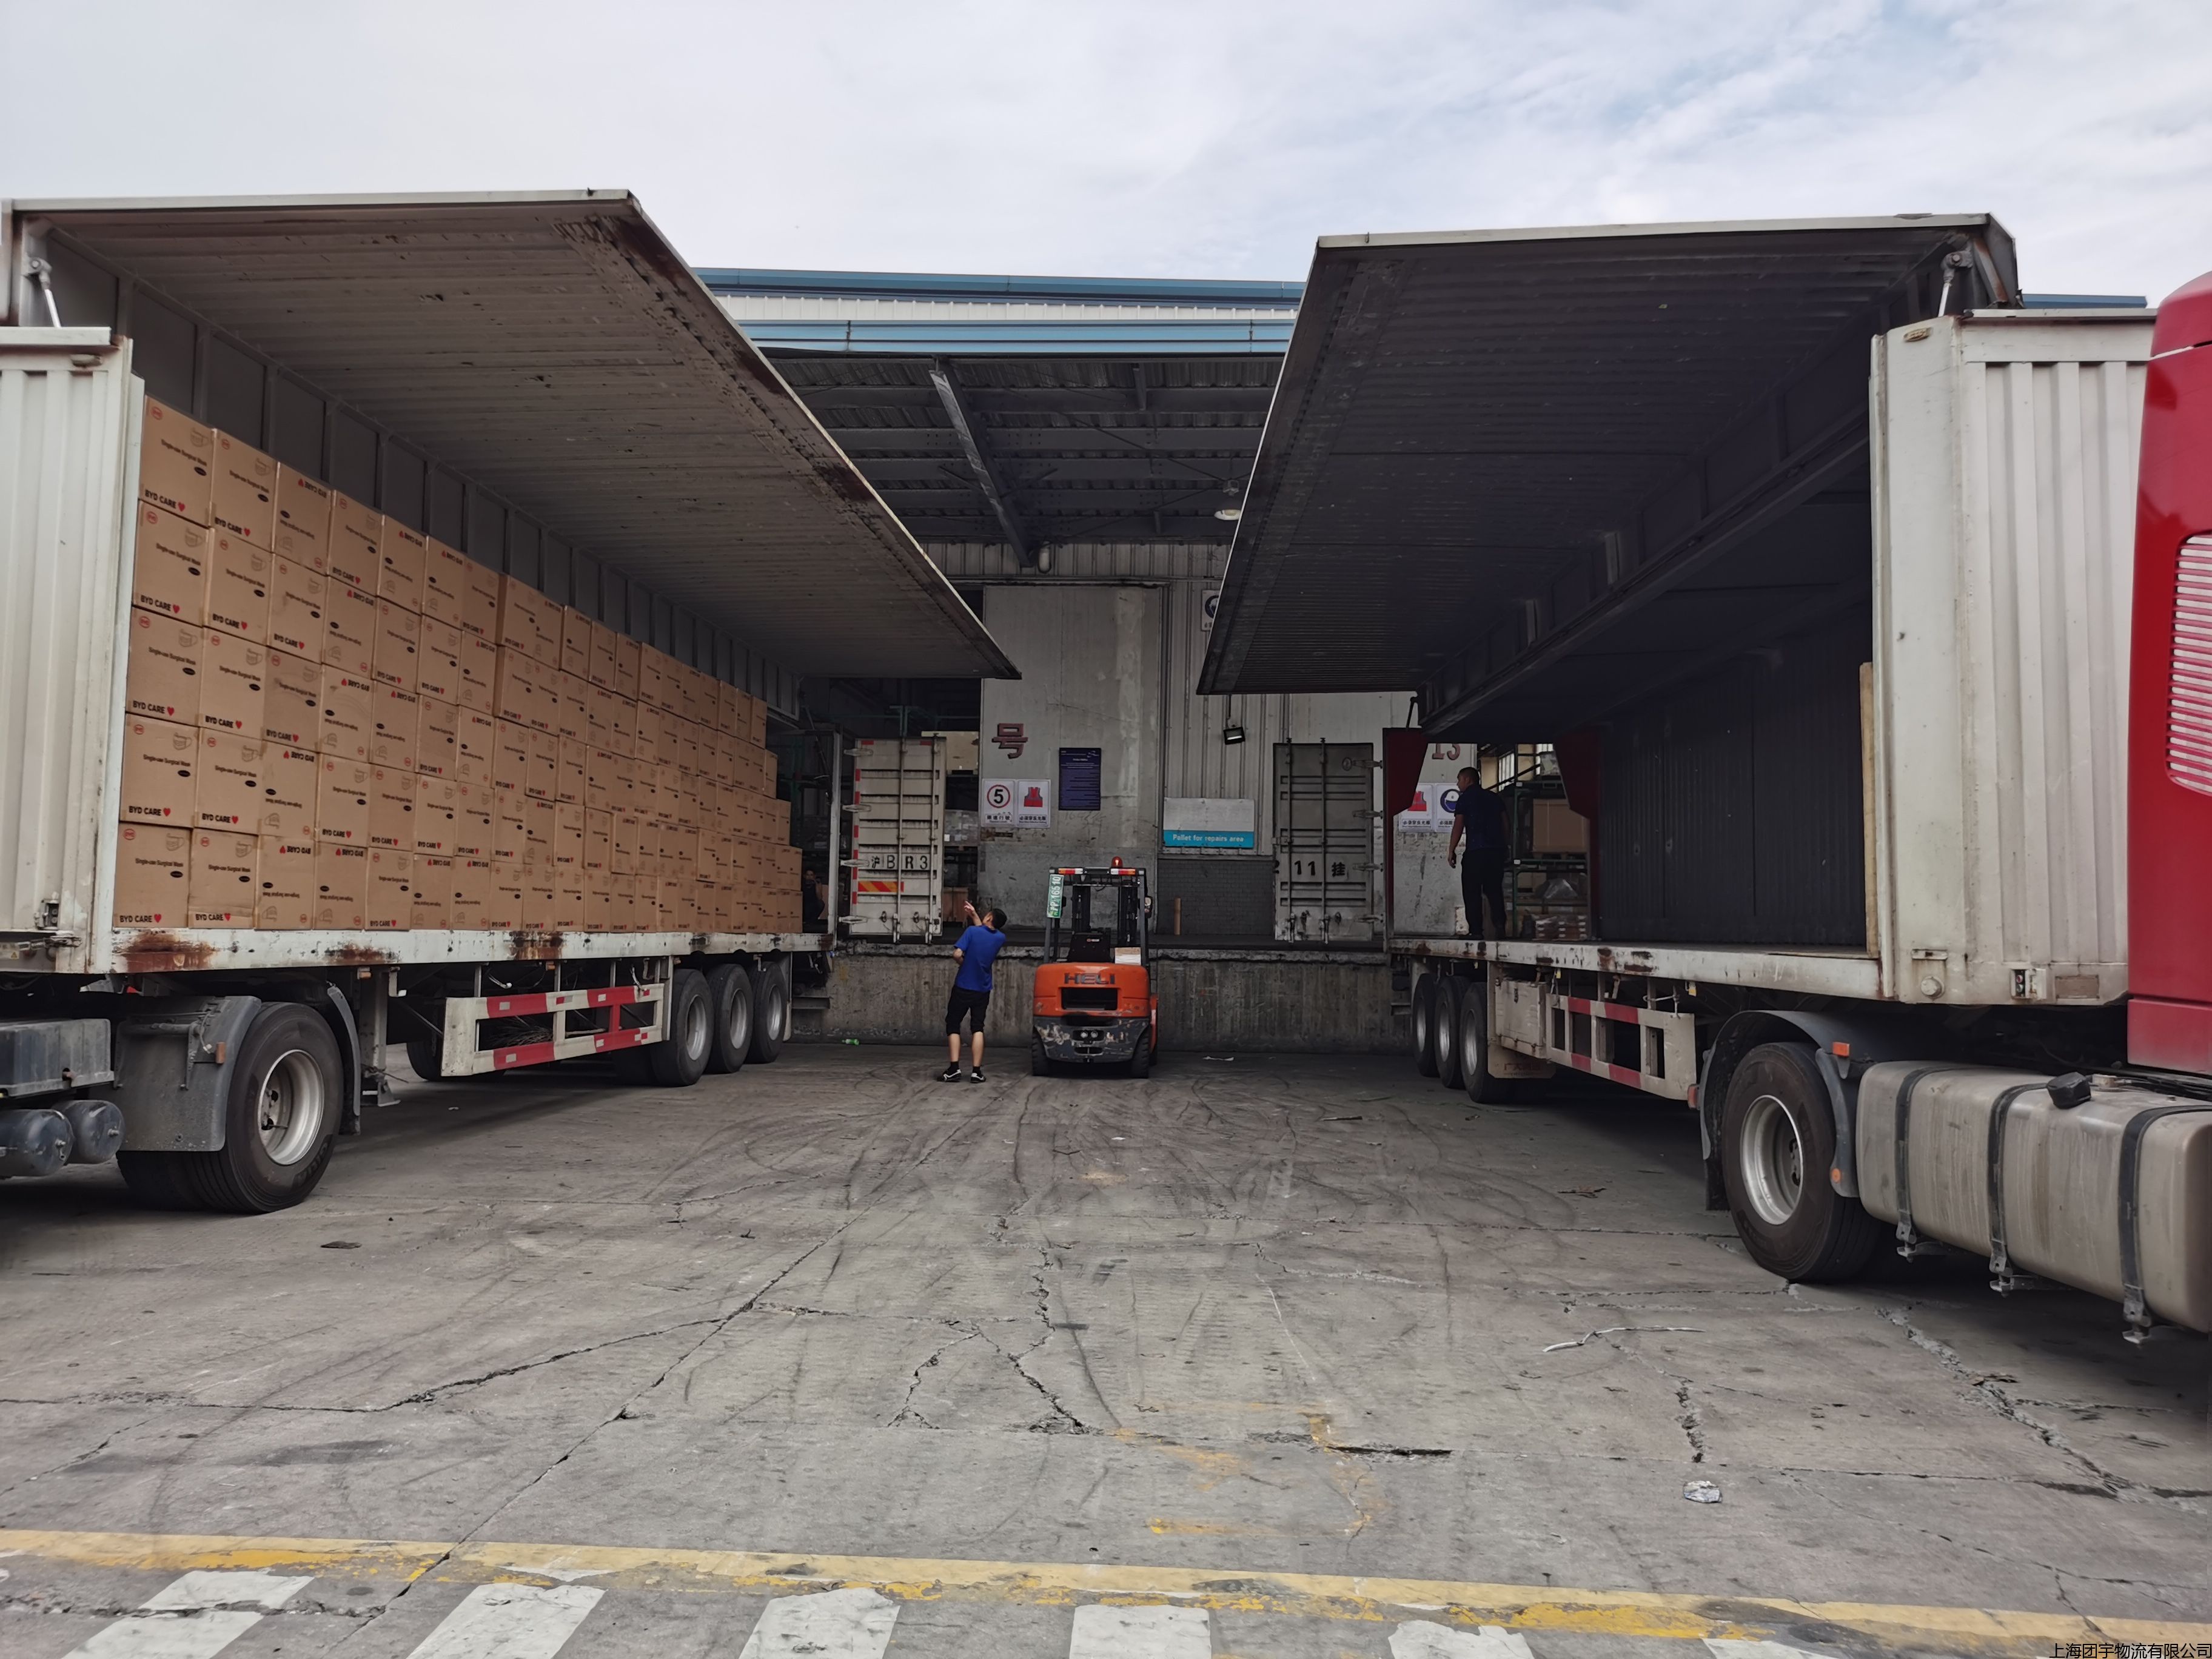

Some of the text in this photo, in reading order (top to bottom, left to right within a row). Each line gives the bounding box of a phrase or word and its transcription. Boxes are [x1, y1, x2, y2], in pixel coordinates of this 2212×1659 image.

[304, 481, 327, 498] BYD CARE
[145, 489, 176, 509] BYD CARE
[214, 517, 242, 535] BYD CARE
[332, 567, 355, 582] BYD CARE
[141, 595, 171, 611] BYD CARE
[354, 592, 374, 606] BYD CARE
[212, 614, 240, 629] BYD CARE
[274, 634, 298, 648] BYD CARE
[169, 653, 186, 662] Surgical
[348, 679, 360, 688] CARE
[133, 700, 165, 714] BYD CARE
[205, 716, 233, 728] BYD CARE
[266, 729, 292, 741] BYD CARE
[991, 723, 1028, 759] 号
[291, 751, 304, 760] CARE
[993, 789, 1004, 804] 5
[129, 805, 161, 816] BYD CARE
[1064, 973, 1115, 985] HELI
